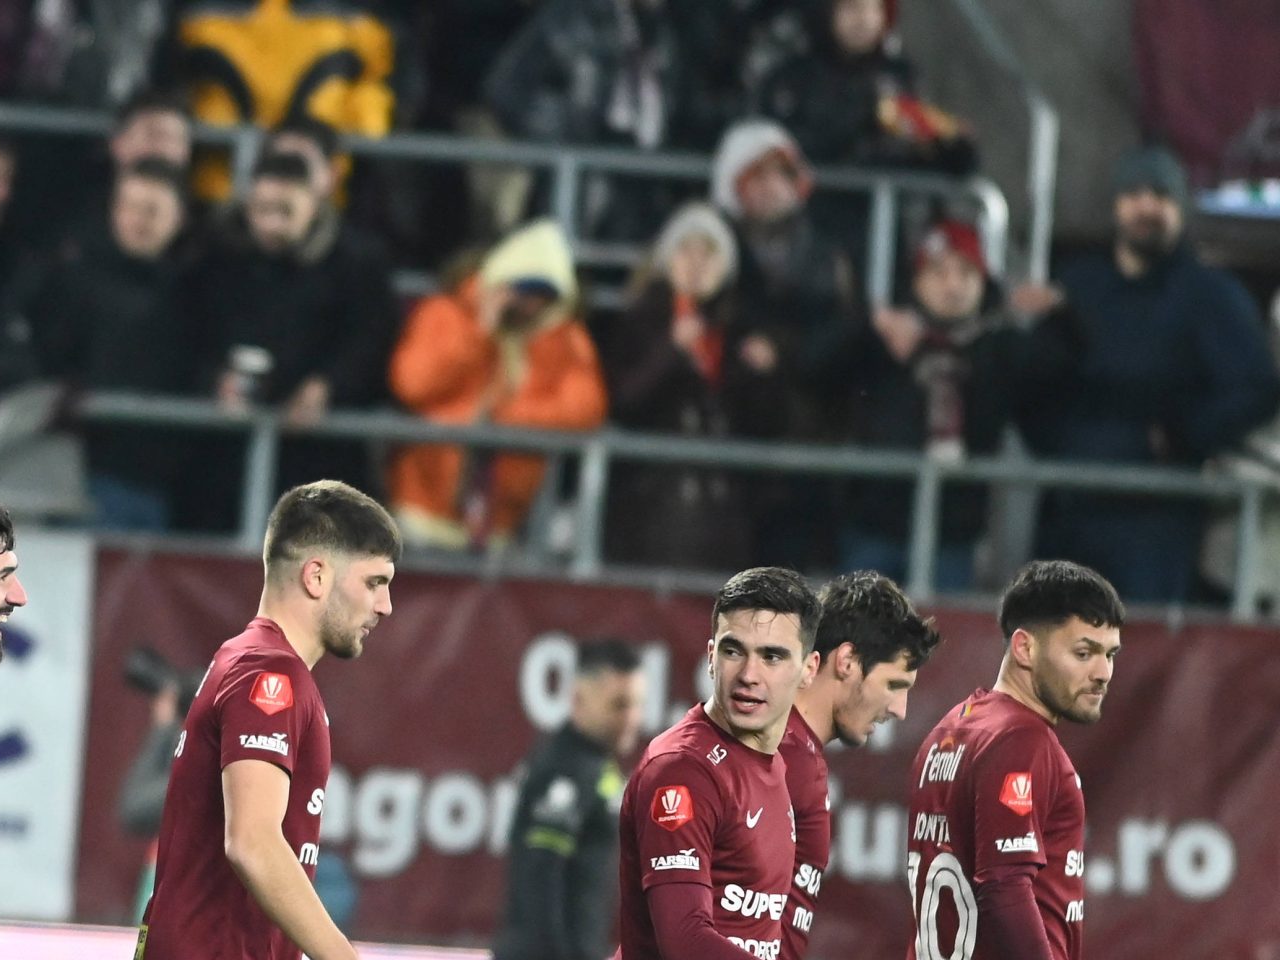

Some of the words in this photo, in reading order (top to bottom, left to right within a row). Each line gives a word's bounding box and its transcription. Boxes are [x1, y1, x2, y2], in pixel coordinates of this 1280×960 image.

[239, 734, 290, 756] TARSIN
[307, 788, 325, 815] S
[651, 851, 700, 871] TARSIN
